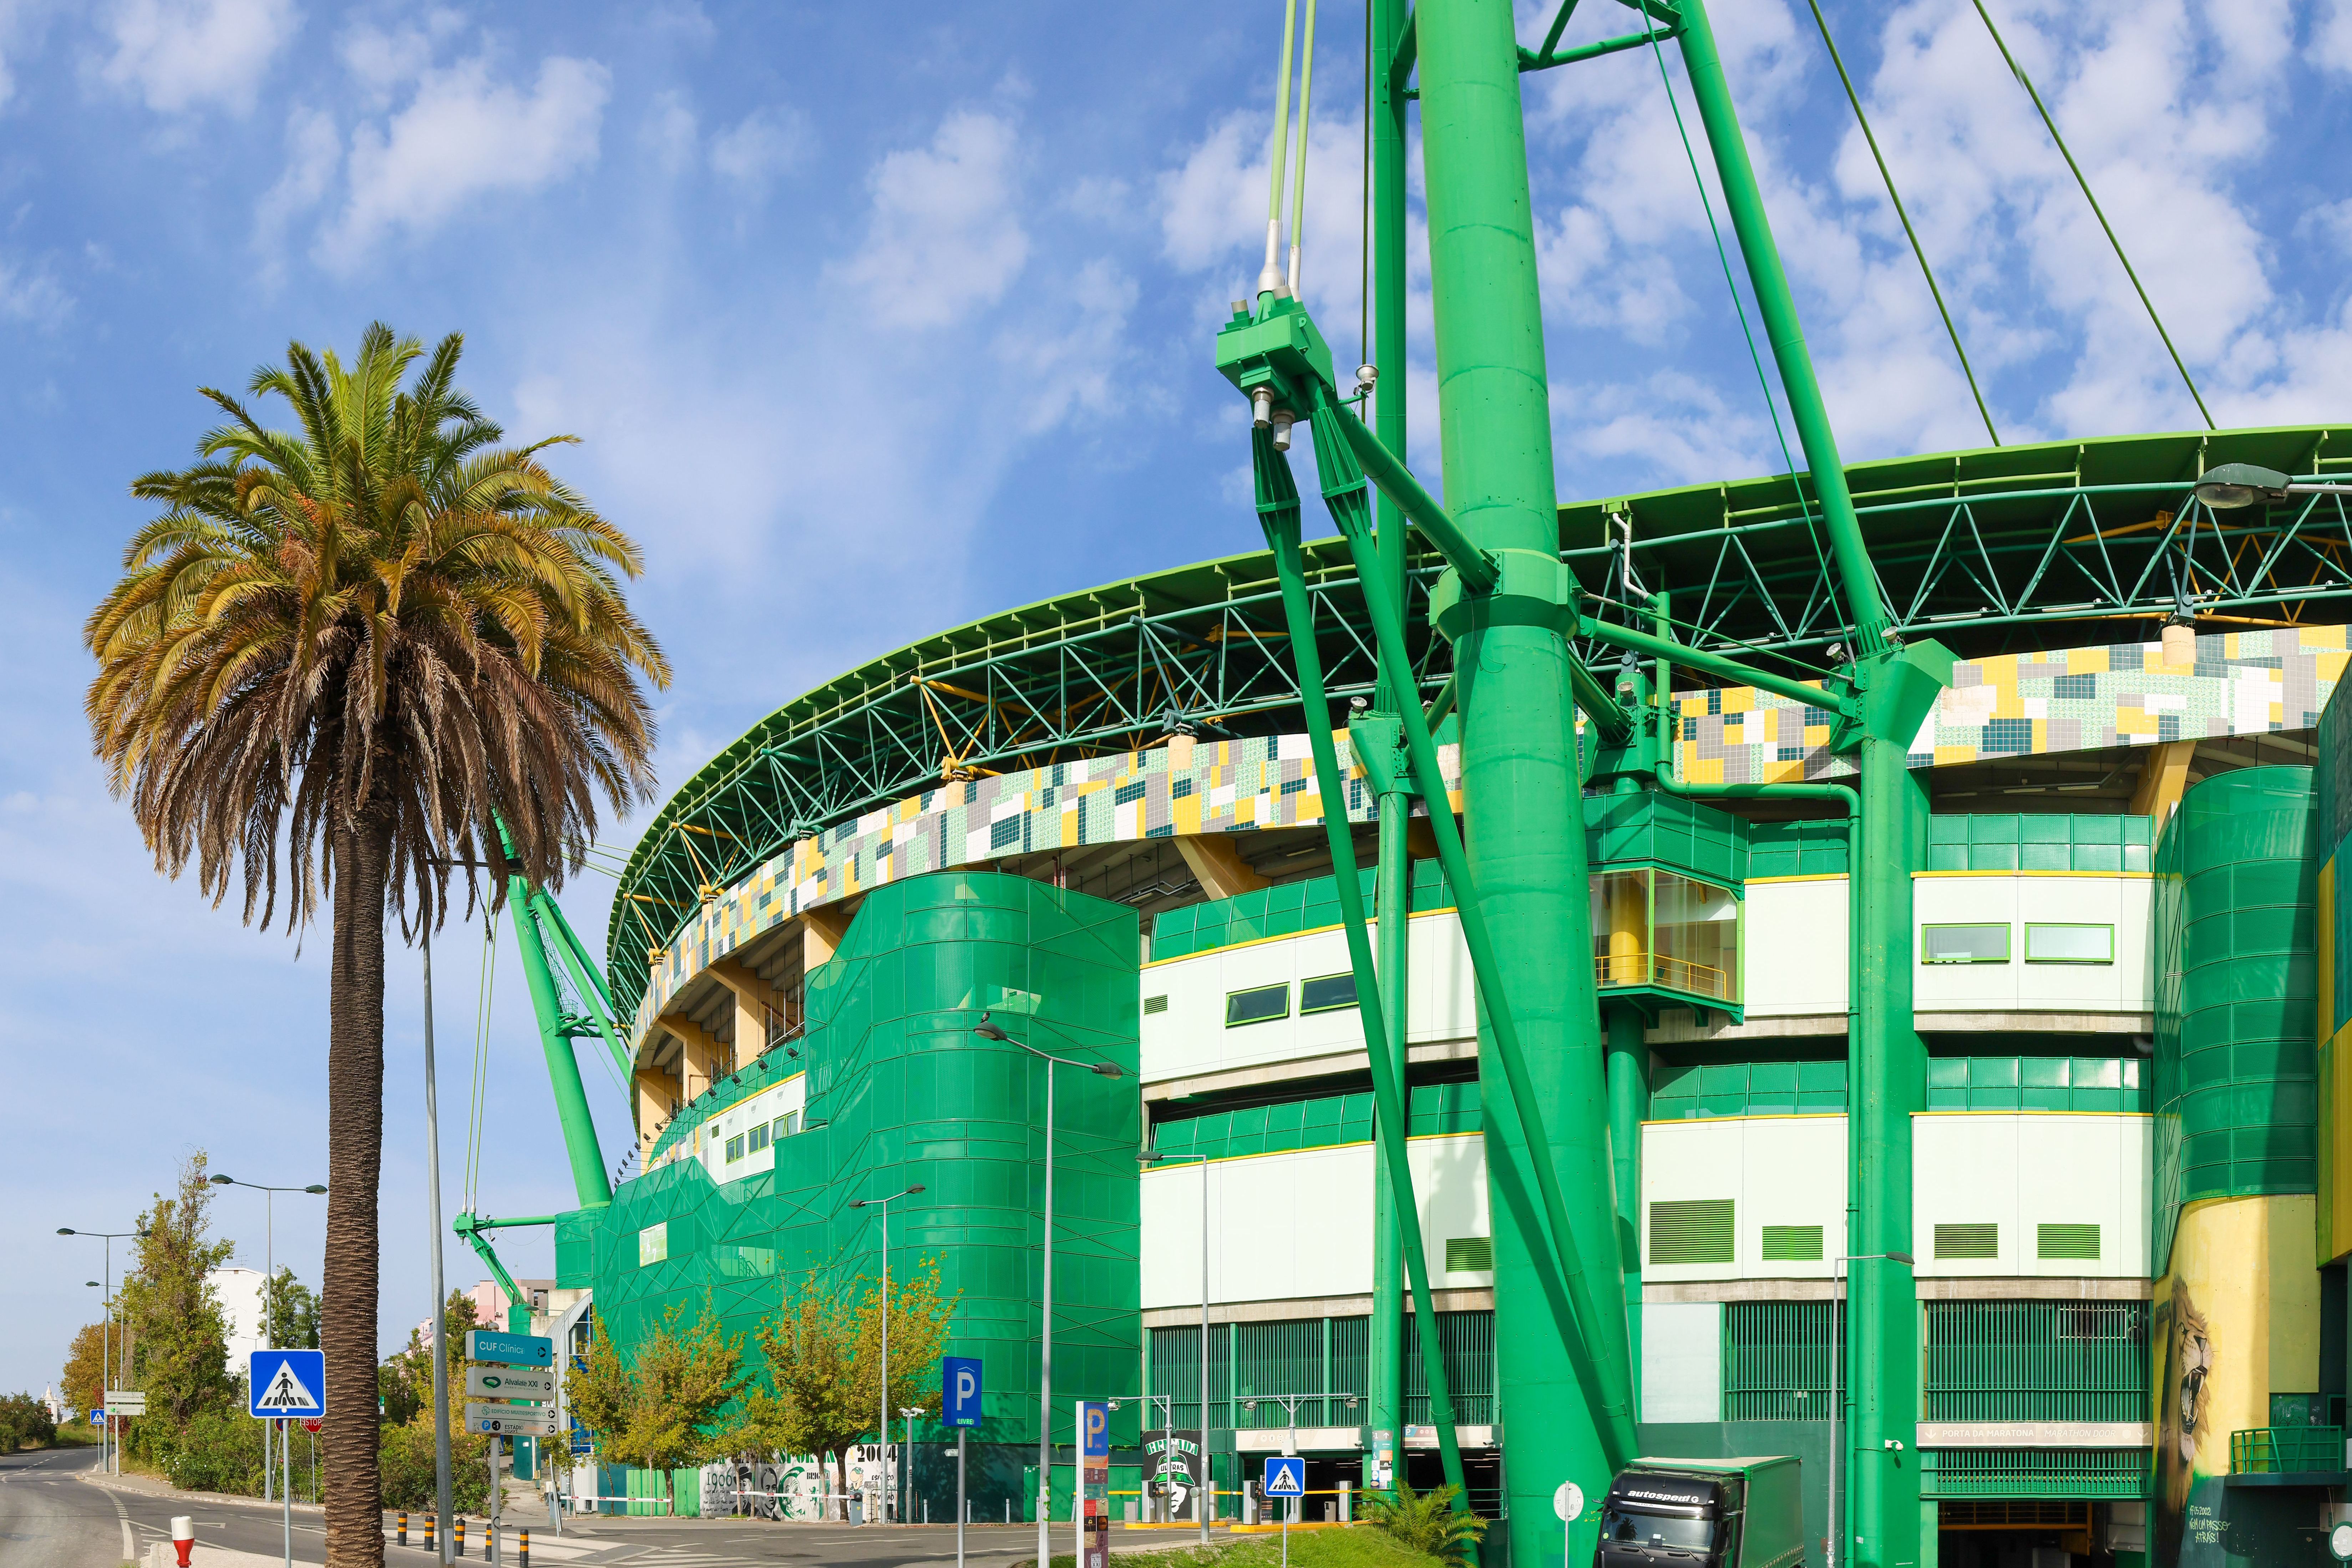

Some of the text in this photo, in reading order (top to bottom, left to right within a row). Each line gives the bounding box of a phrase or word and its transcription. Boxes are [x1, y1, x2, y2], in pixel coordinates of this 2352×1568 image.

[647, 1238, 650, 1253] 6
[652, 1248, 657, 1263] 7
[479, 1341, 497, 1351] CUF
[957, 1371, 975, 1411] P
[1087, 1409, 1105, 1448] P
[1146, 1439, 1198, 1456] BRIADA
[707, 1466, 733, 1492] 1906
[2206, 1519, 2231, 1531] PASSO
